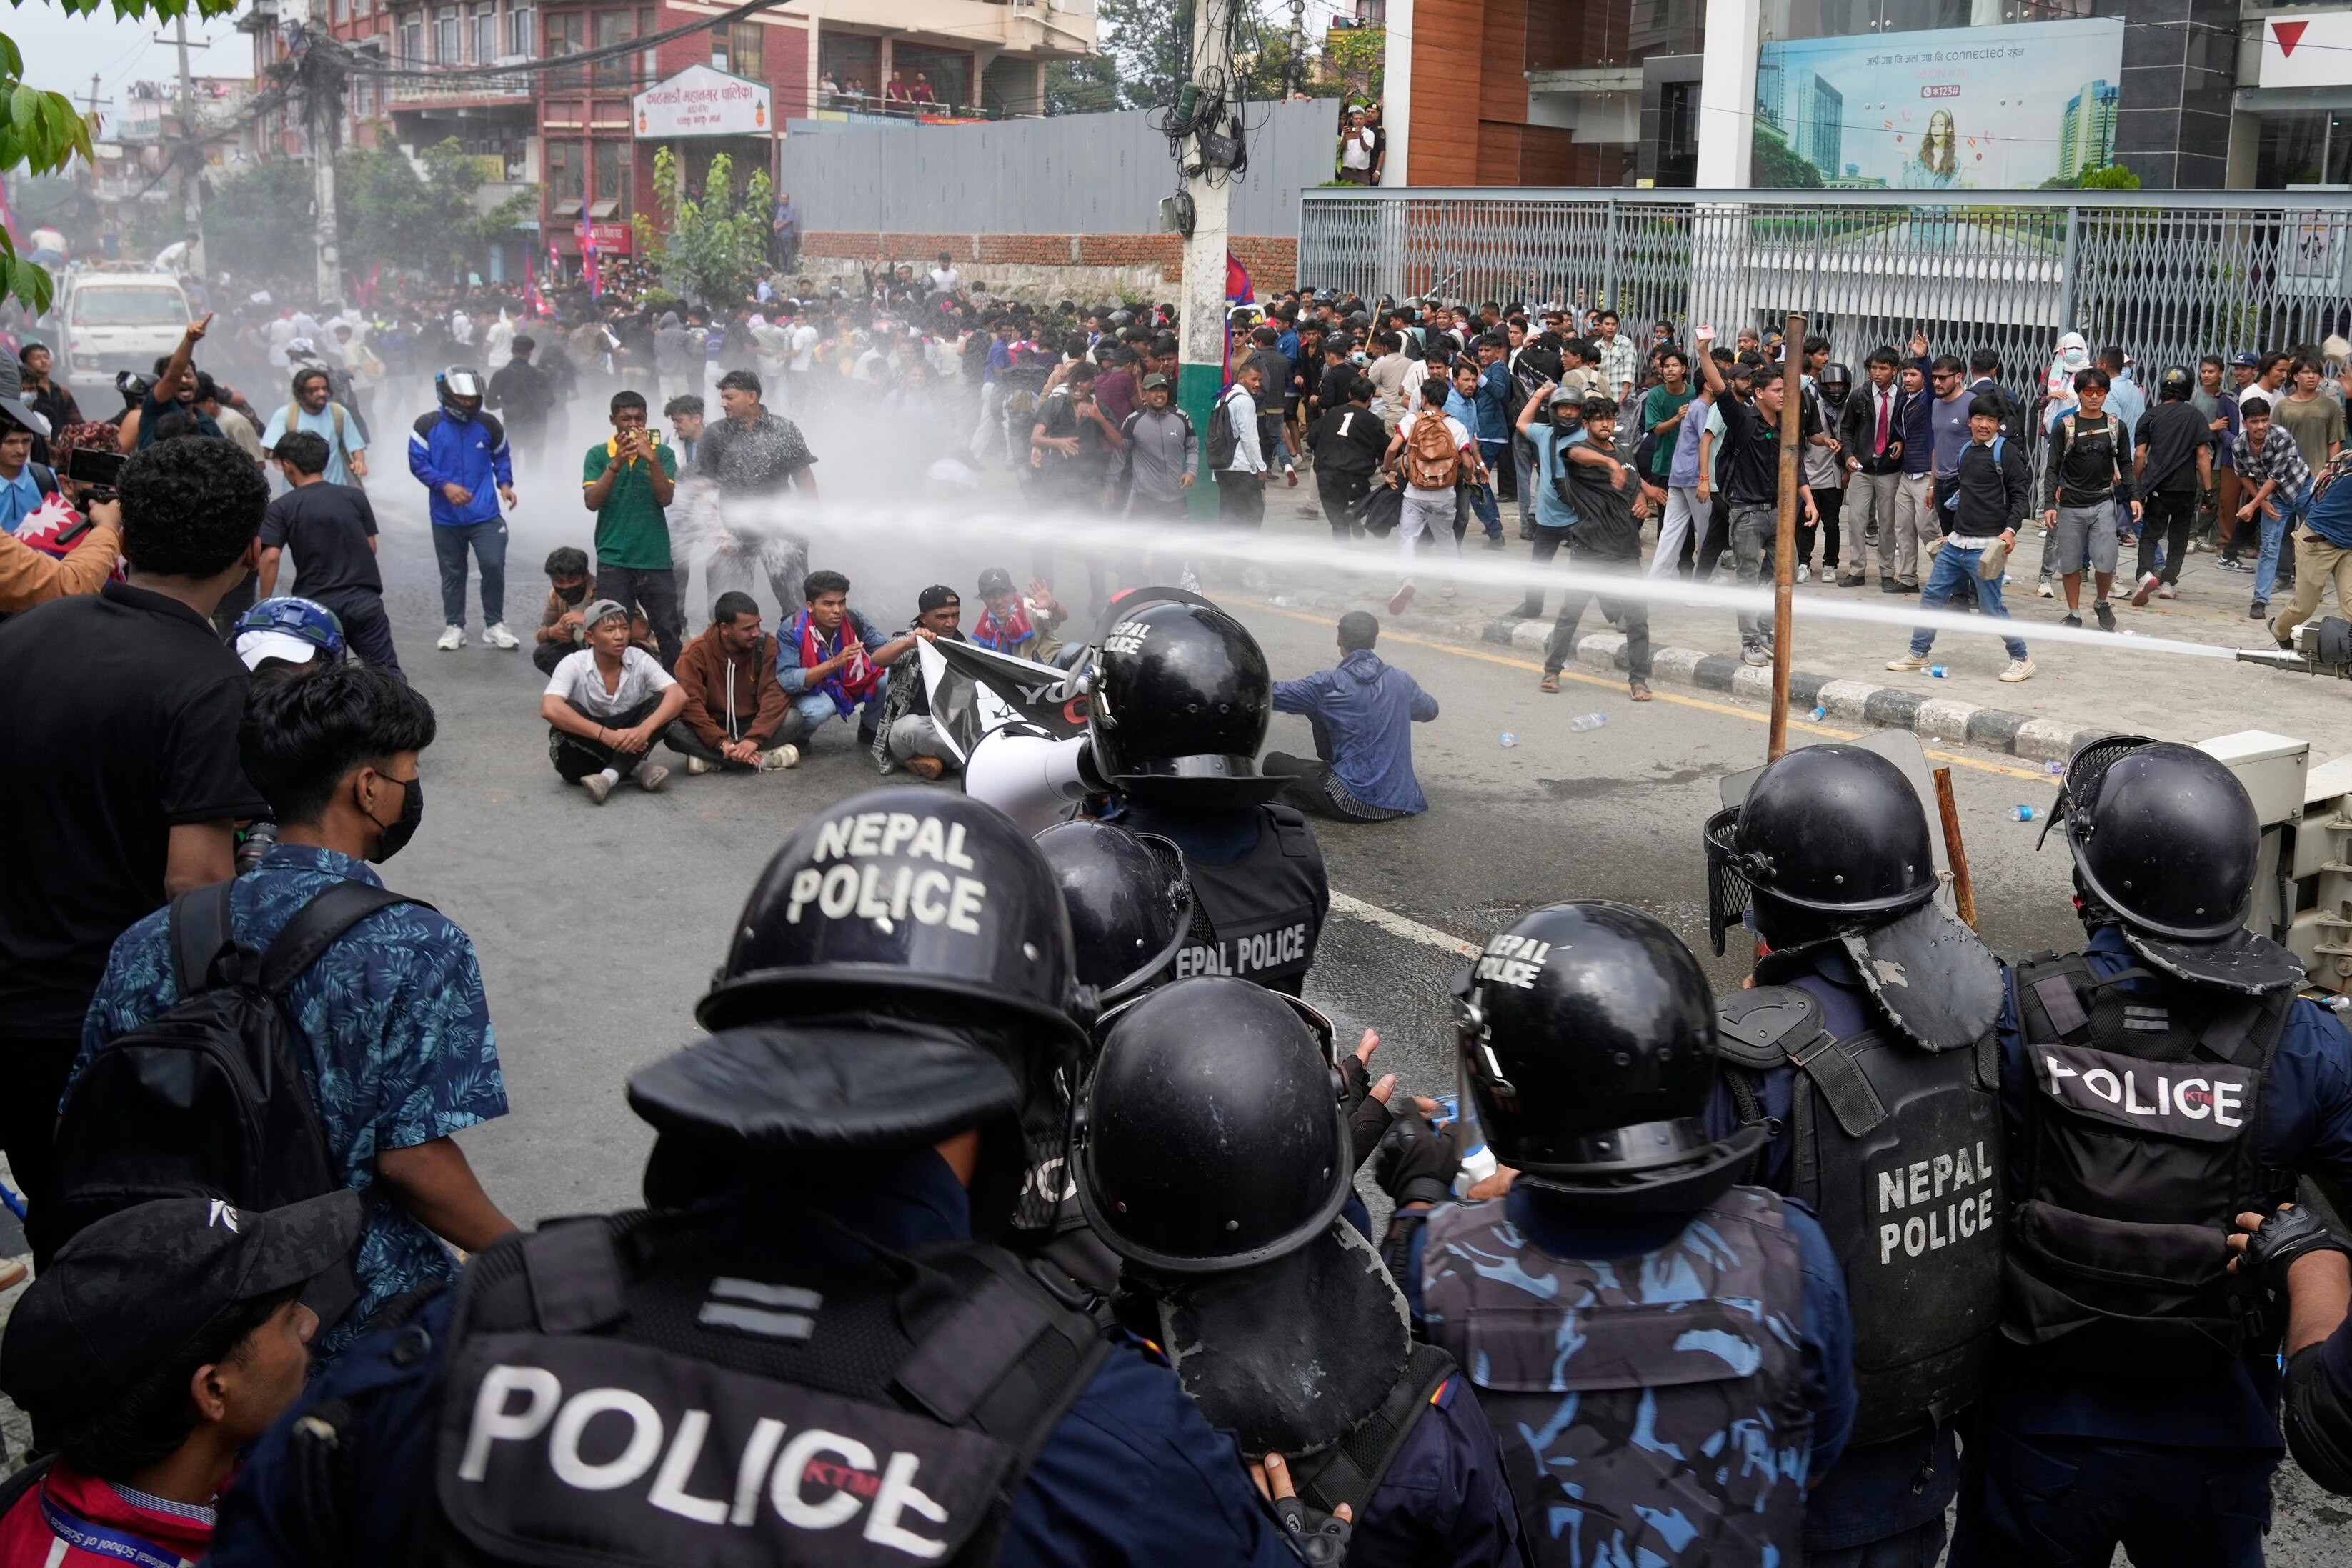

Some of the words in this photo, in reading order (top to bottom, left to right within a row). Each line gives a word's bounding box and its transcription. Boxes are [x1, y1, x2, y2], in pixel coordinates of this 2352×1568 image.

[1946, 46, 2004, 61] connected
[1337, 411, 1355, 437] 1
[1104, 636, 1143, 655] OLICE
[812, 812, 975, 872] NEPAL
[787, 863, 987, 936] POLICE
[1176, 942, 1232, 979] EPAL
[1237, 923, 1305, 974] POLICE
[1484, 934, 1551, 964] NEPAL
[1474, 957, 1542, 989] POLICE
[2046, 1055, 2243, 1127] POLICE
[2185, 1091, 2214, 1105] KTM
[1878, 1141, 1992, 1213] NEPAL
[1880, 1188, 1993, 1265] POLICE
[457, 1364, 948, 1559] POLICE
[802, 1457, 882, 1498] KTM
[81, 1535, 98, 1547] of
[96, 1539, 137, 1559] School
[134, 1549, 175, 1568] ational
